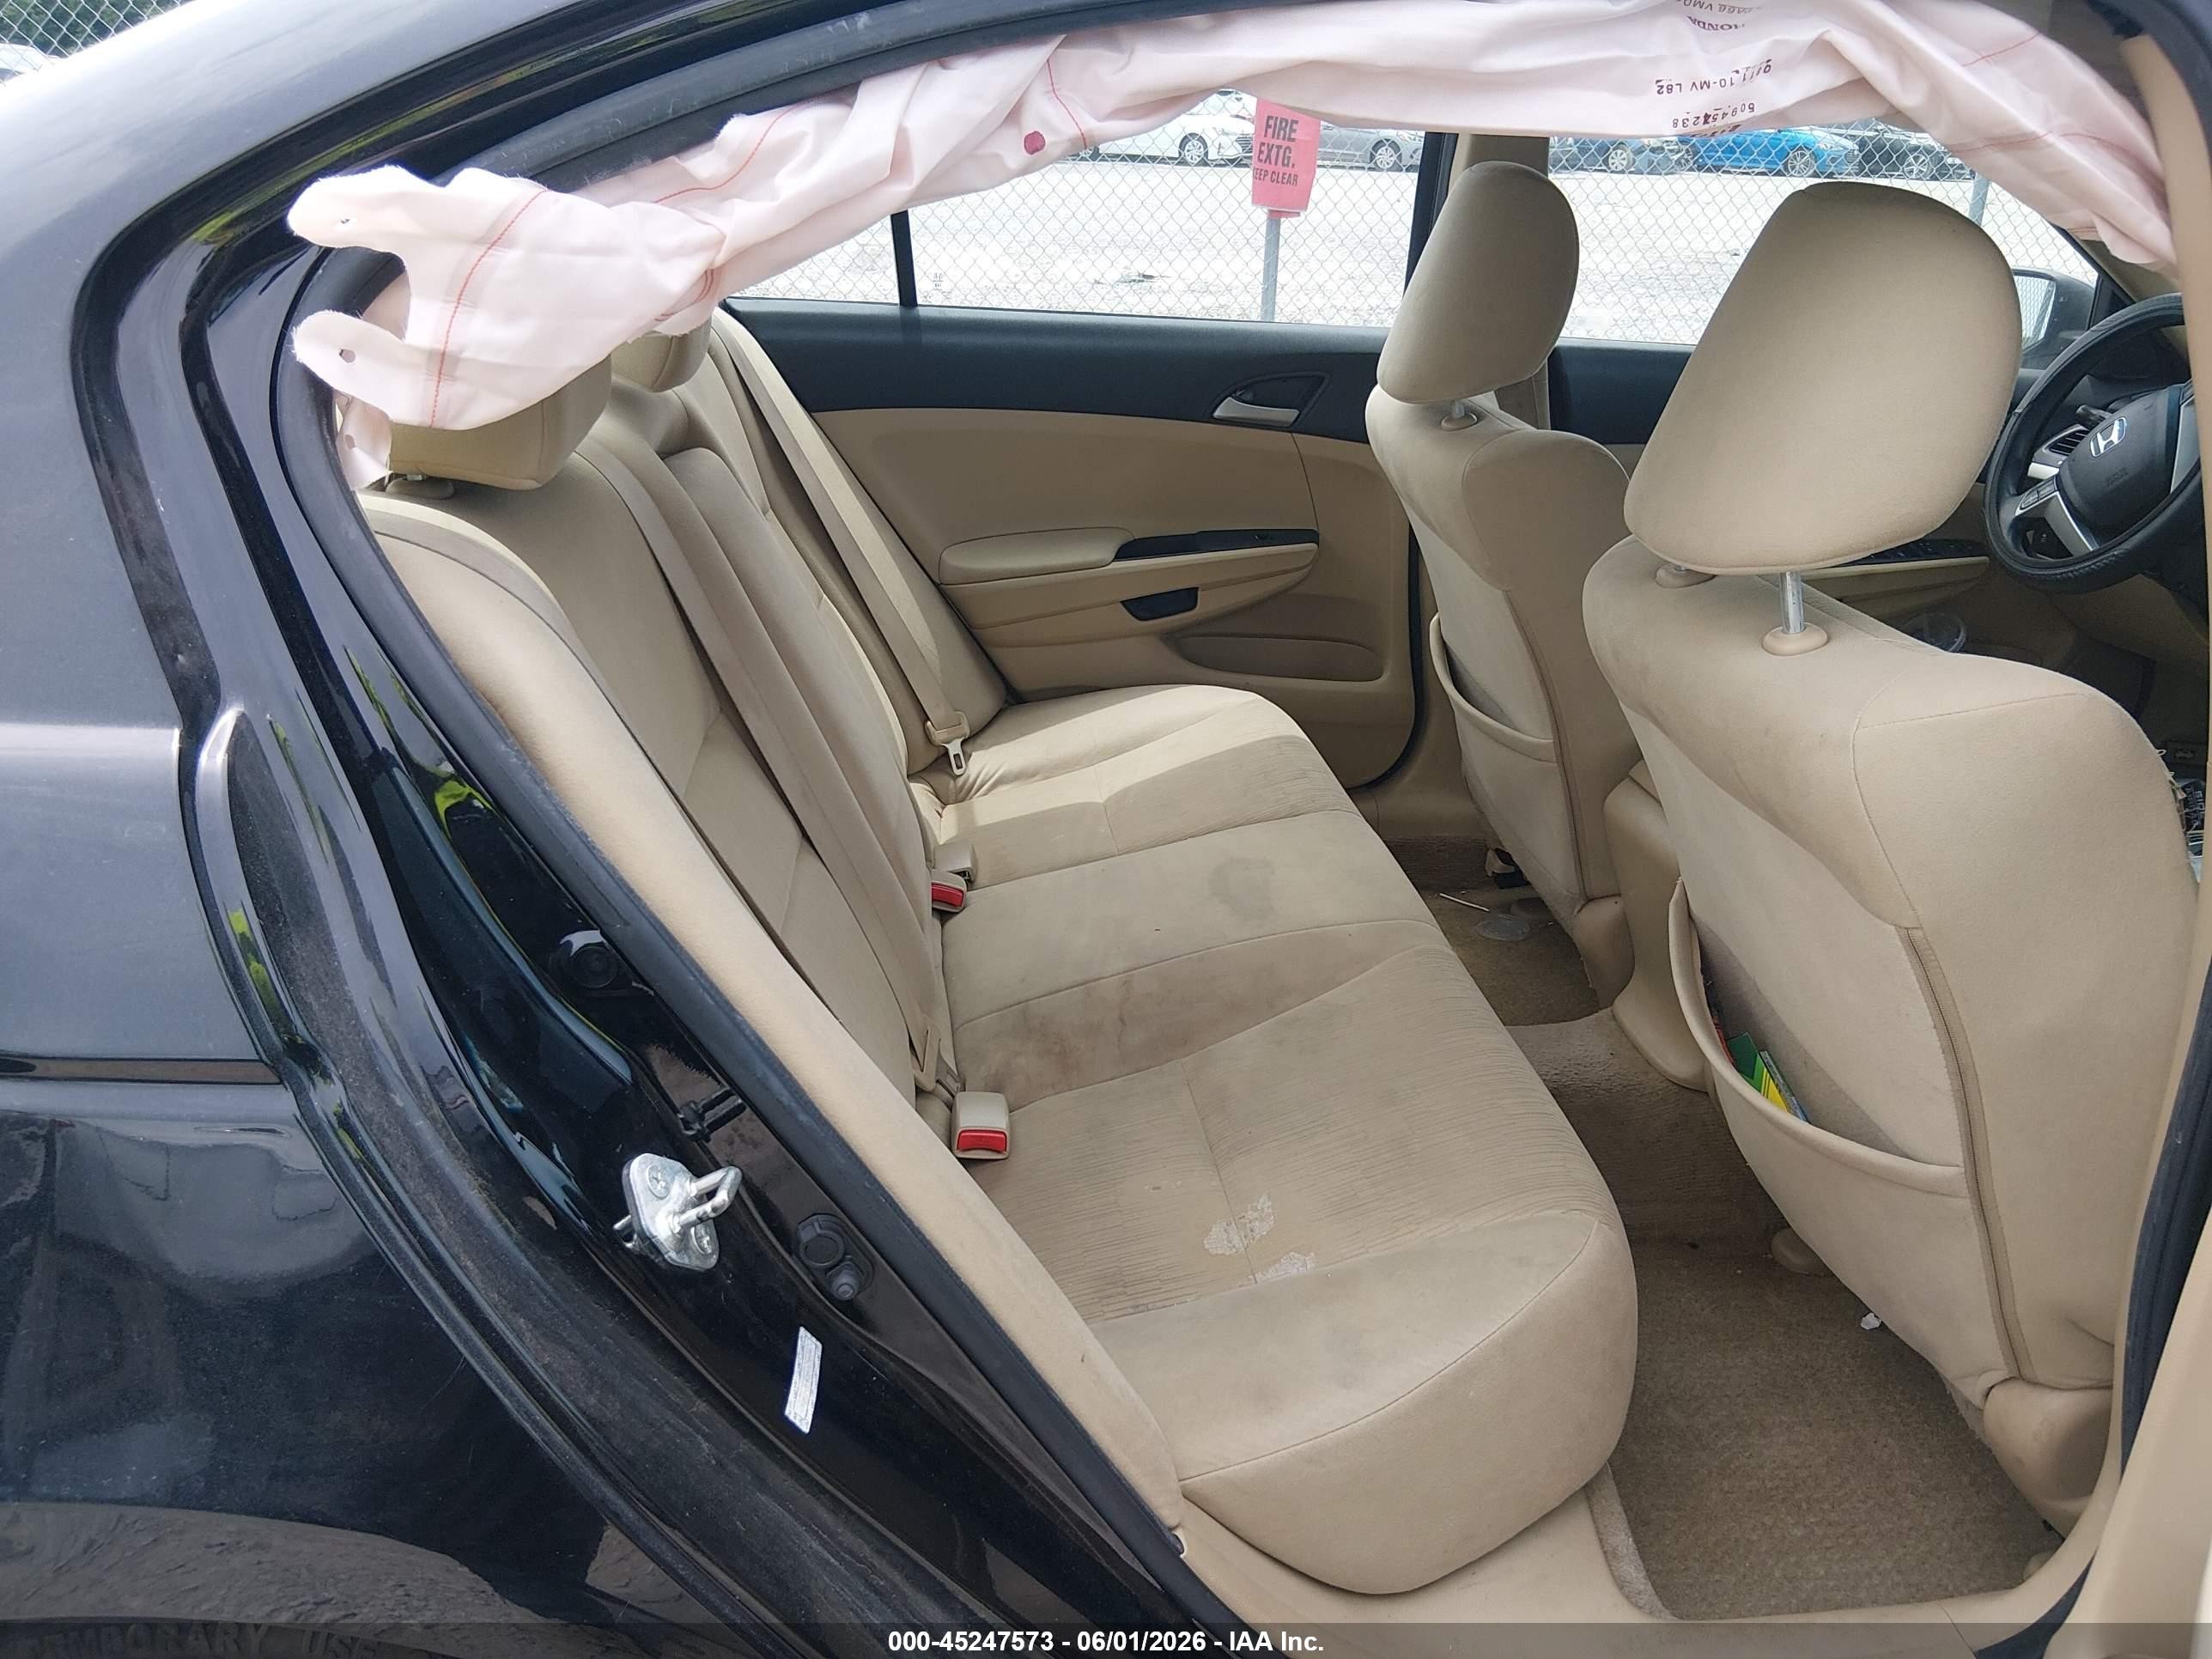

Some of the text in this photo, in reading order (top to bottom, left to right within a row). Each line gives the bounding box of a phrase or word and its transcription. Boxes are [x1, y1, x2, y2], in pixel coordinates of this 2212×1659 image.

[1264, 115, 1298, 141] FIRE
[1257, 142, 1295, 167] EXTG.
[1270, 171, 1298, 185] CLEAR
